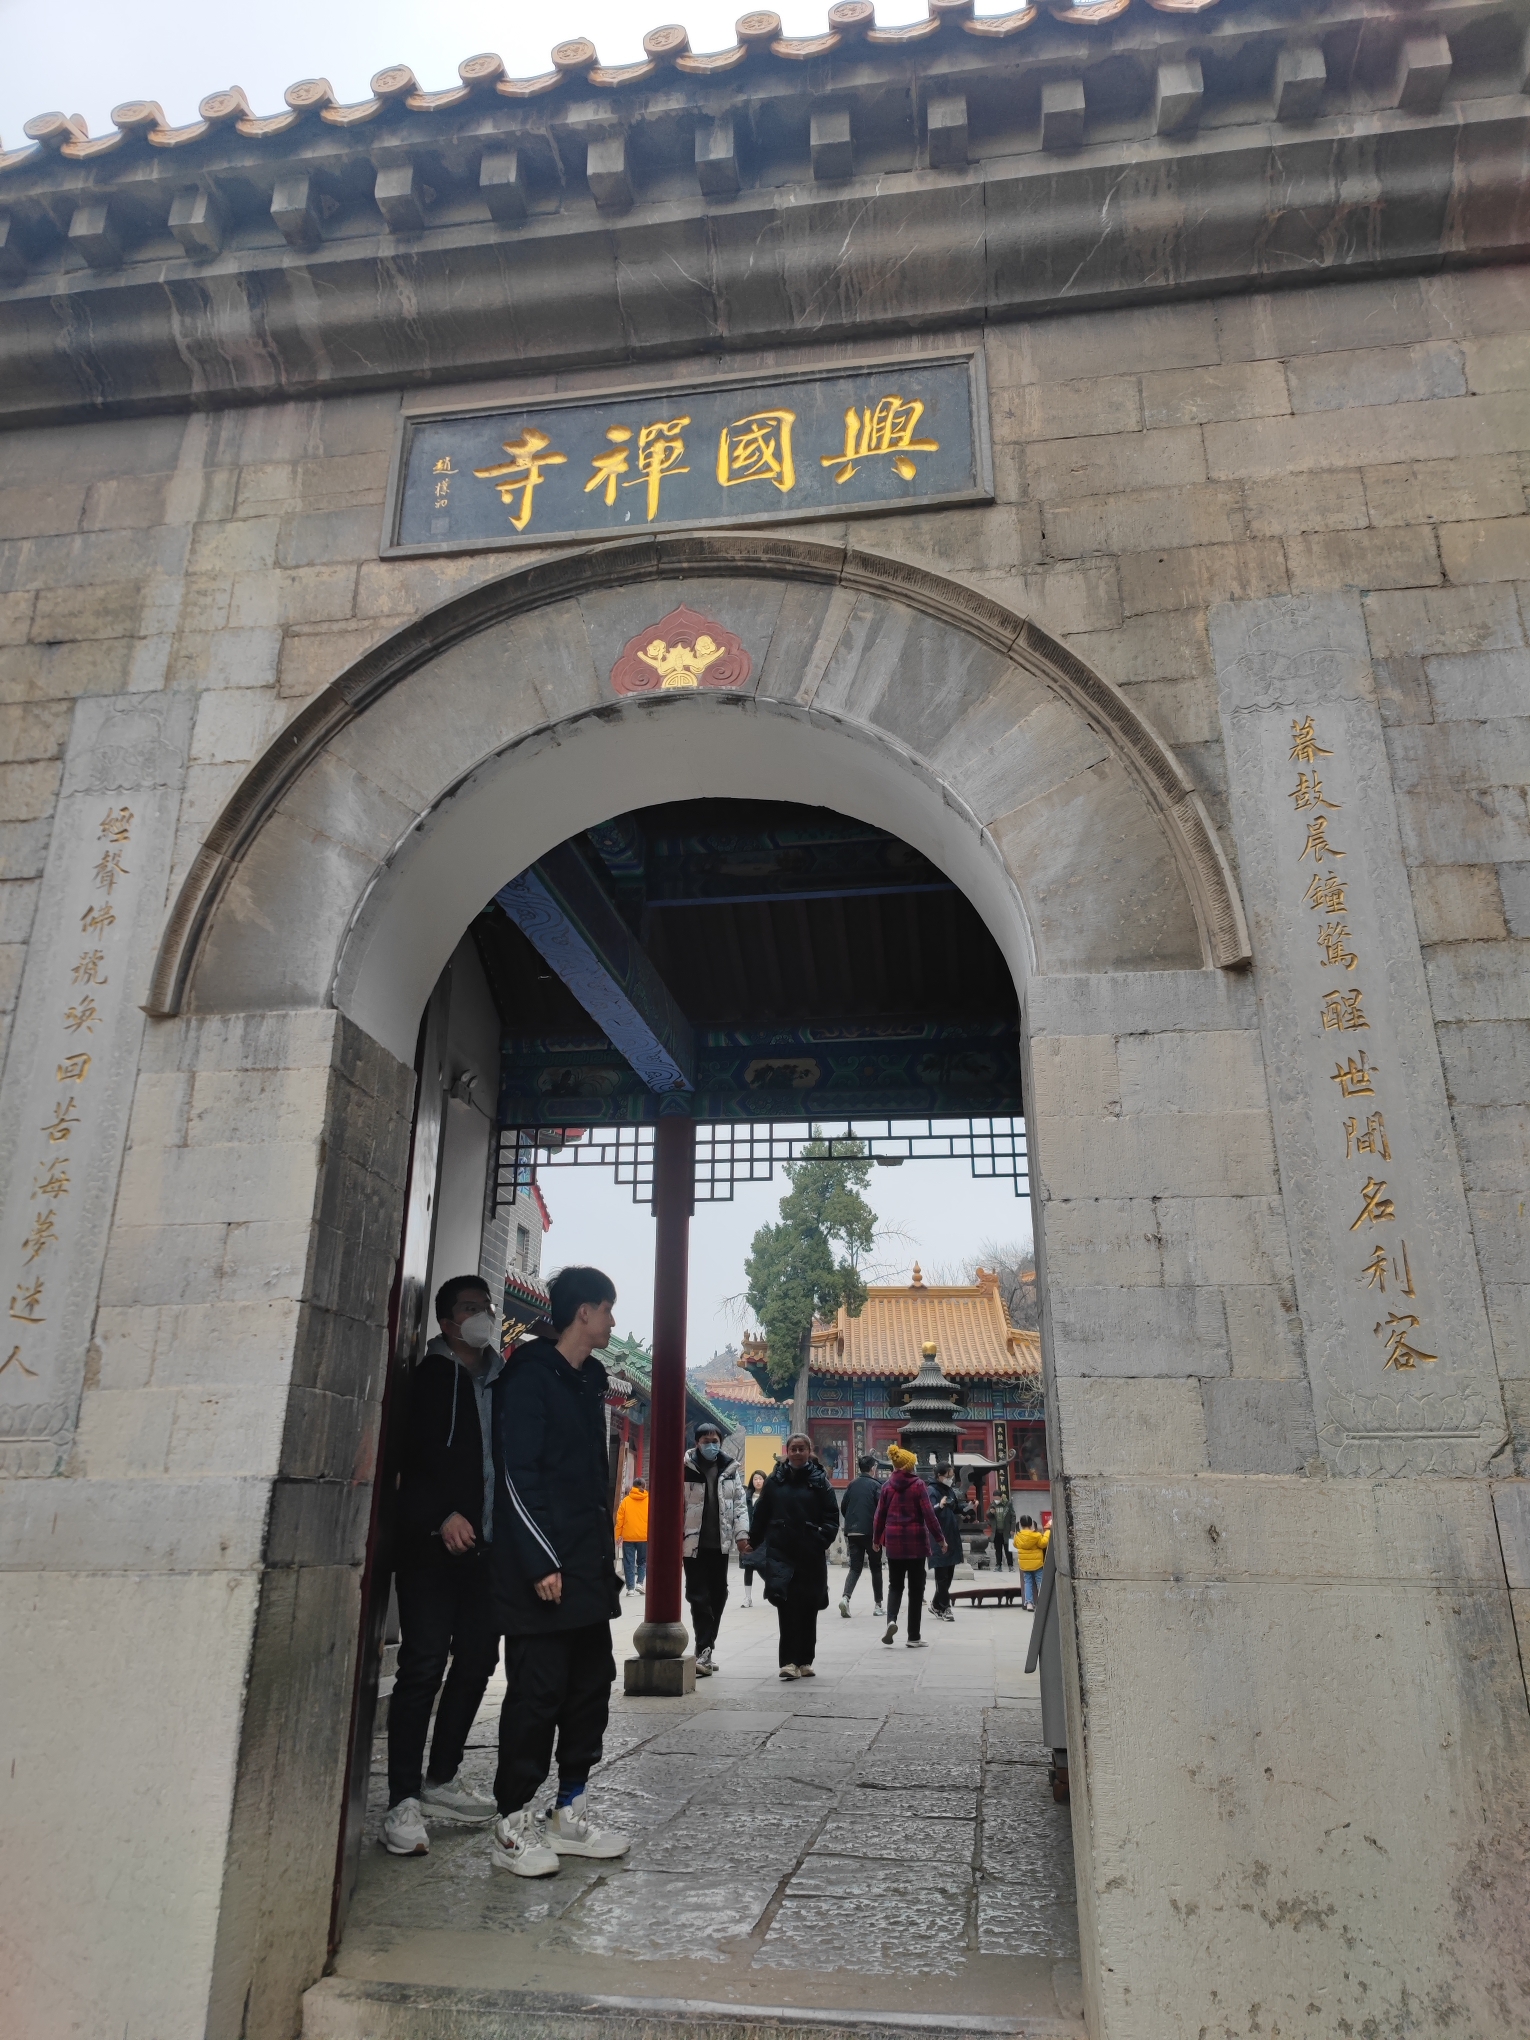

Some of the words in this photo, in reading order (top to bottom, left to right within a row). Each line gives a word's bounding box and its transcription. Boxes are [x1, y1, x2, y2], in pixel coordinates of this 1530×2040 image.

[1288, 715, 1439, 1372] 暮鼓晨鐘驚醒世間名利客
